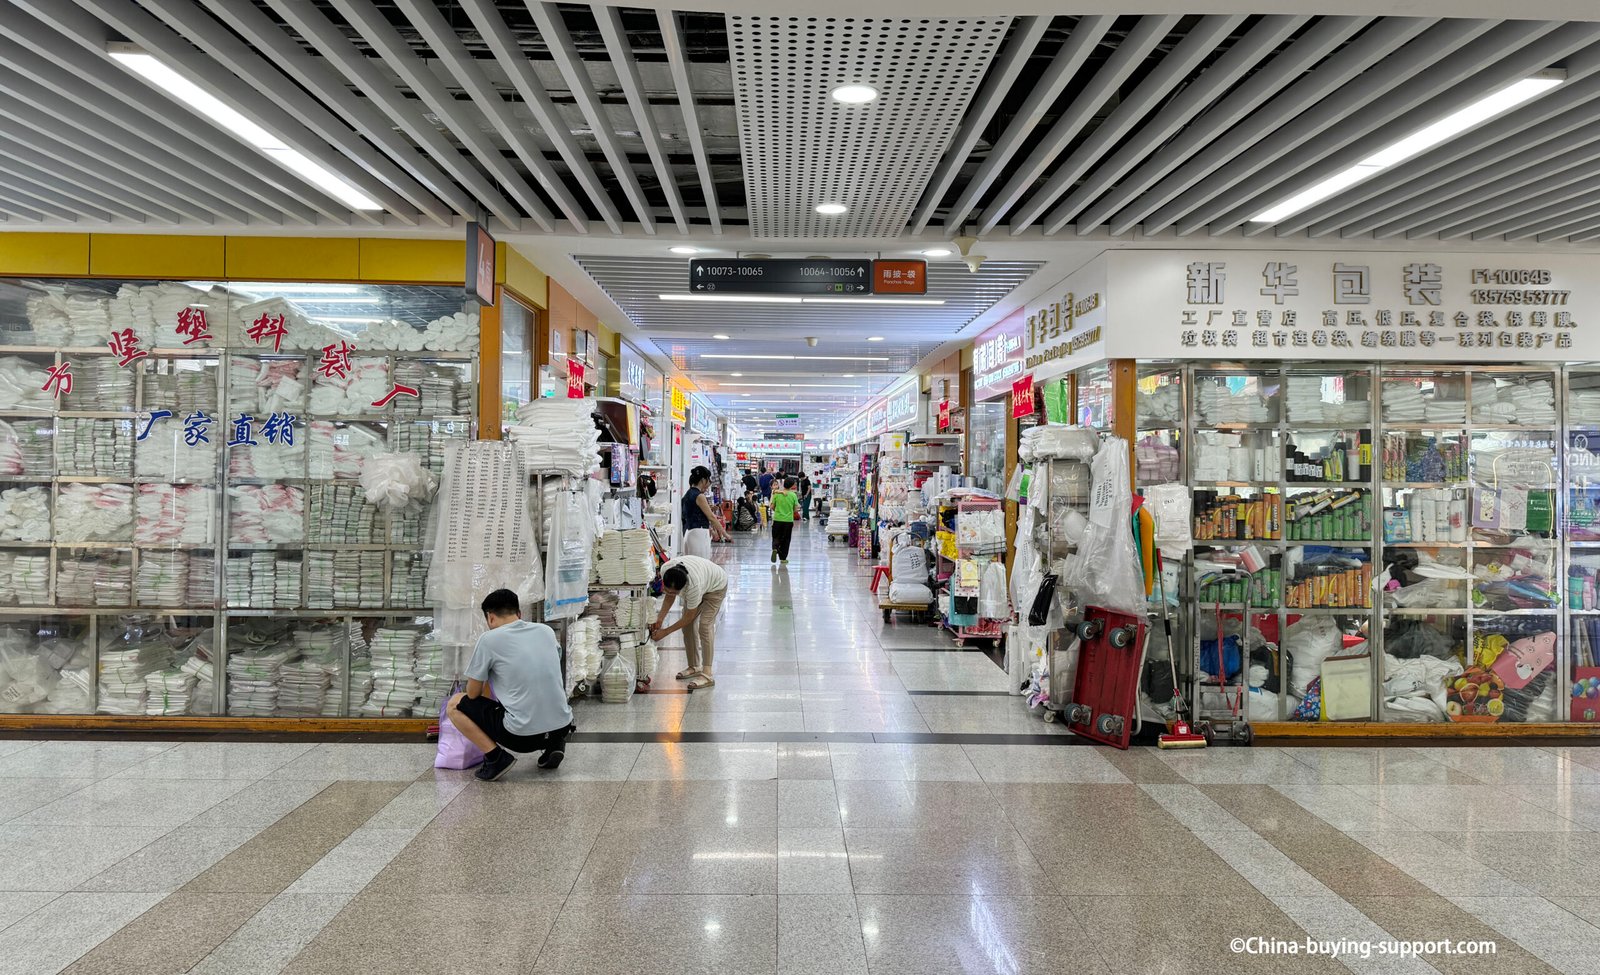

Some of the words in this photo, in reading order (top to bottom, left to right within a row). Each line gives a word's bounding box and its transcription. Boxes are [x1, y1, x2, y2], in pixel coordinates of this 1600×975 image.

[706, 266, 764, 276] 10073-10065
[799, 267, 856, 277] 10064-10056
[1471, 269, 1552, 285] F1-10064B
[1186, 261, 1443, 305] 新华包装
[1471, 289, 1571, 305] 13575953777
[1181, 310, 1297, 327] 工厂直营店
[1181, 330, 1239, 347] 垃圾袋
[137, 409, 296, 447] 厂家直销
